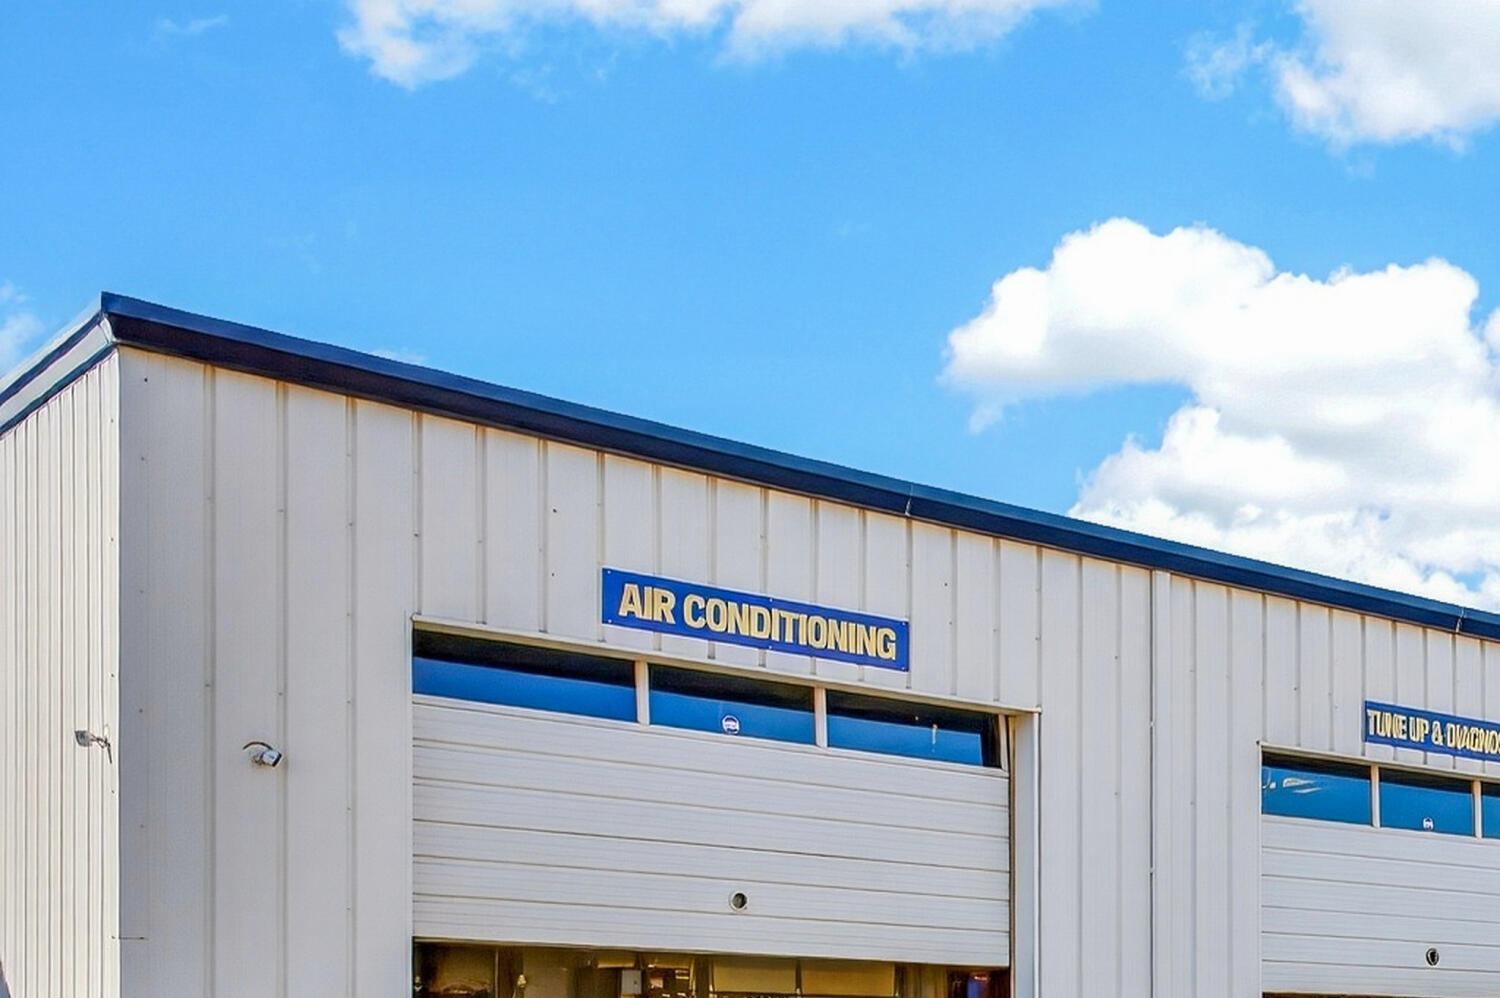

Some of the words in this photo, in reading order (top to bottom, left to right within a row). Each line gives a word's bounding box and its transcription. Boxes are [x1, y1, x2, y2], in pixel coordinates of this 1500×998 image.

[617, 583, 676, 625] AIR
[683, 593, 897, 661] CONDITIONING
[1366, 709, 1407, 740] TUNE
[1409, 716, 1430, 743] UP
[1431, 720, 1444, 746] &
